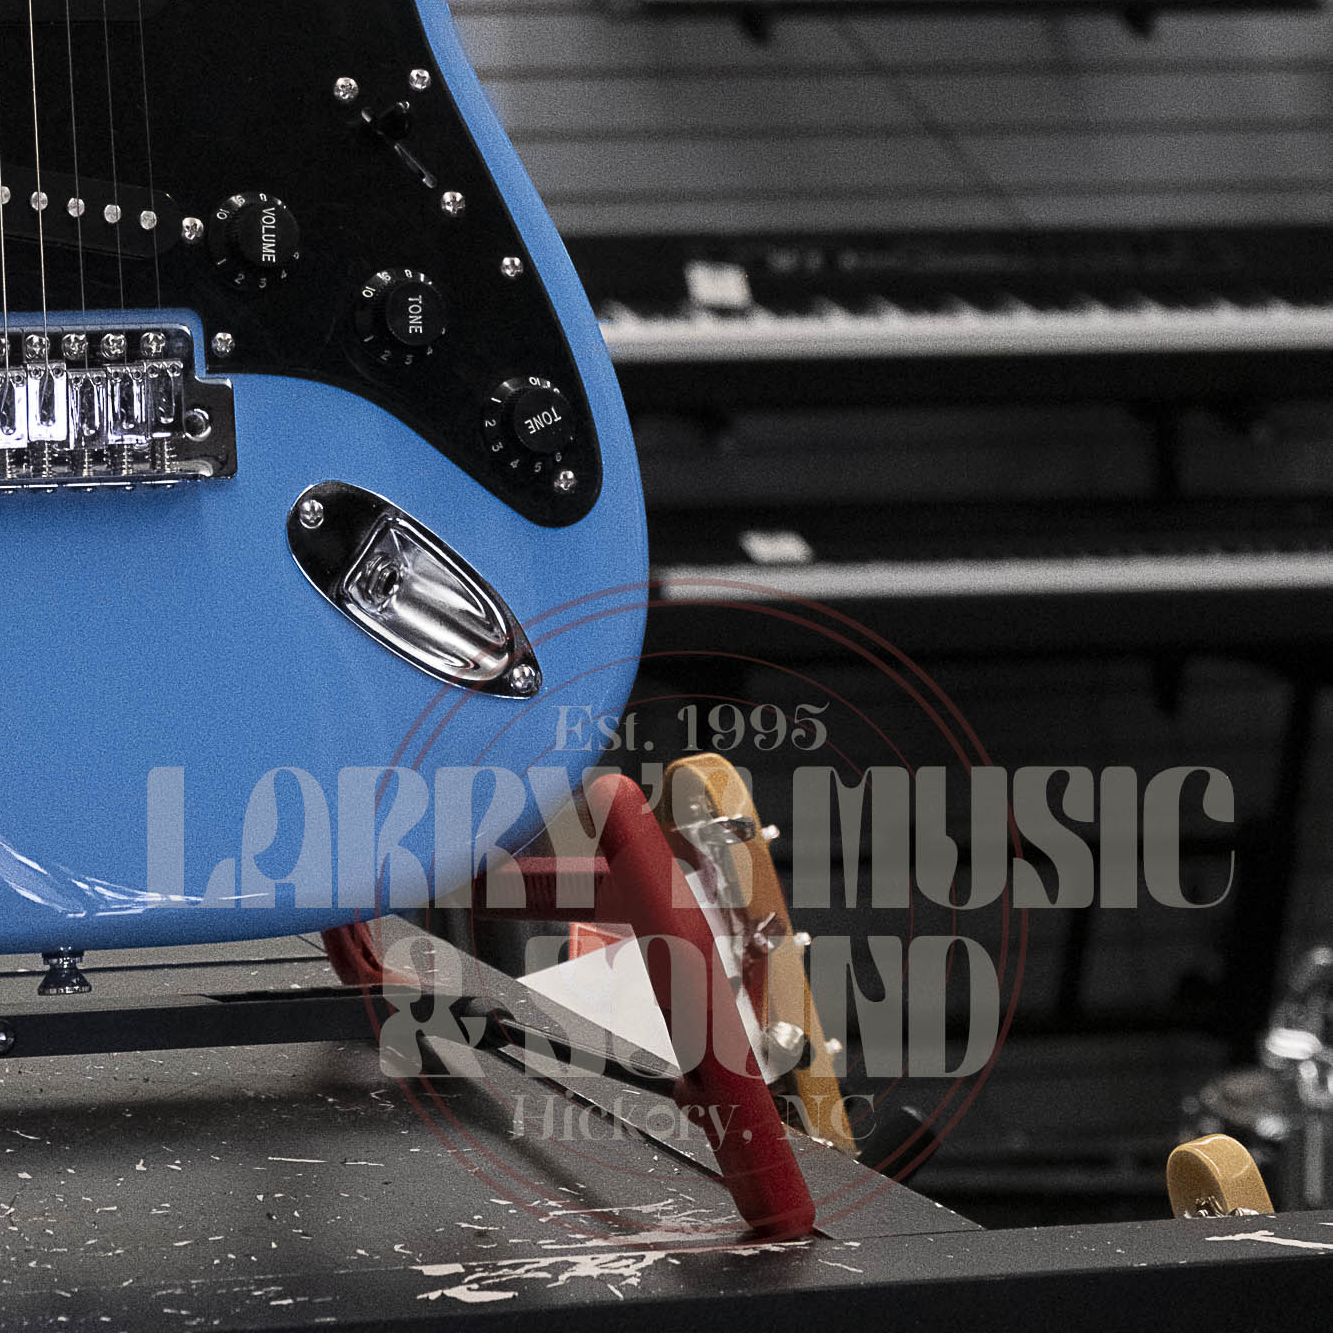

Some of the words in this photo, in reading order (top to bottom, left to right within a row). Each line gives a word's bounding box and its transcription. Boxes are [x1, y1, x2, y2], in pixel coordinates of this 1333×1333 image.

[261, 207, 276, 263] VOLUME
[408, 294, 423, 334] TONE
[524, 406, 562, 434] TONE
